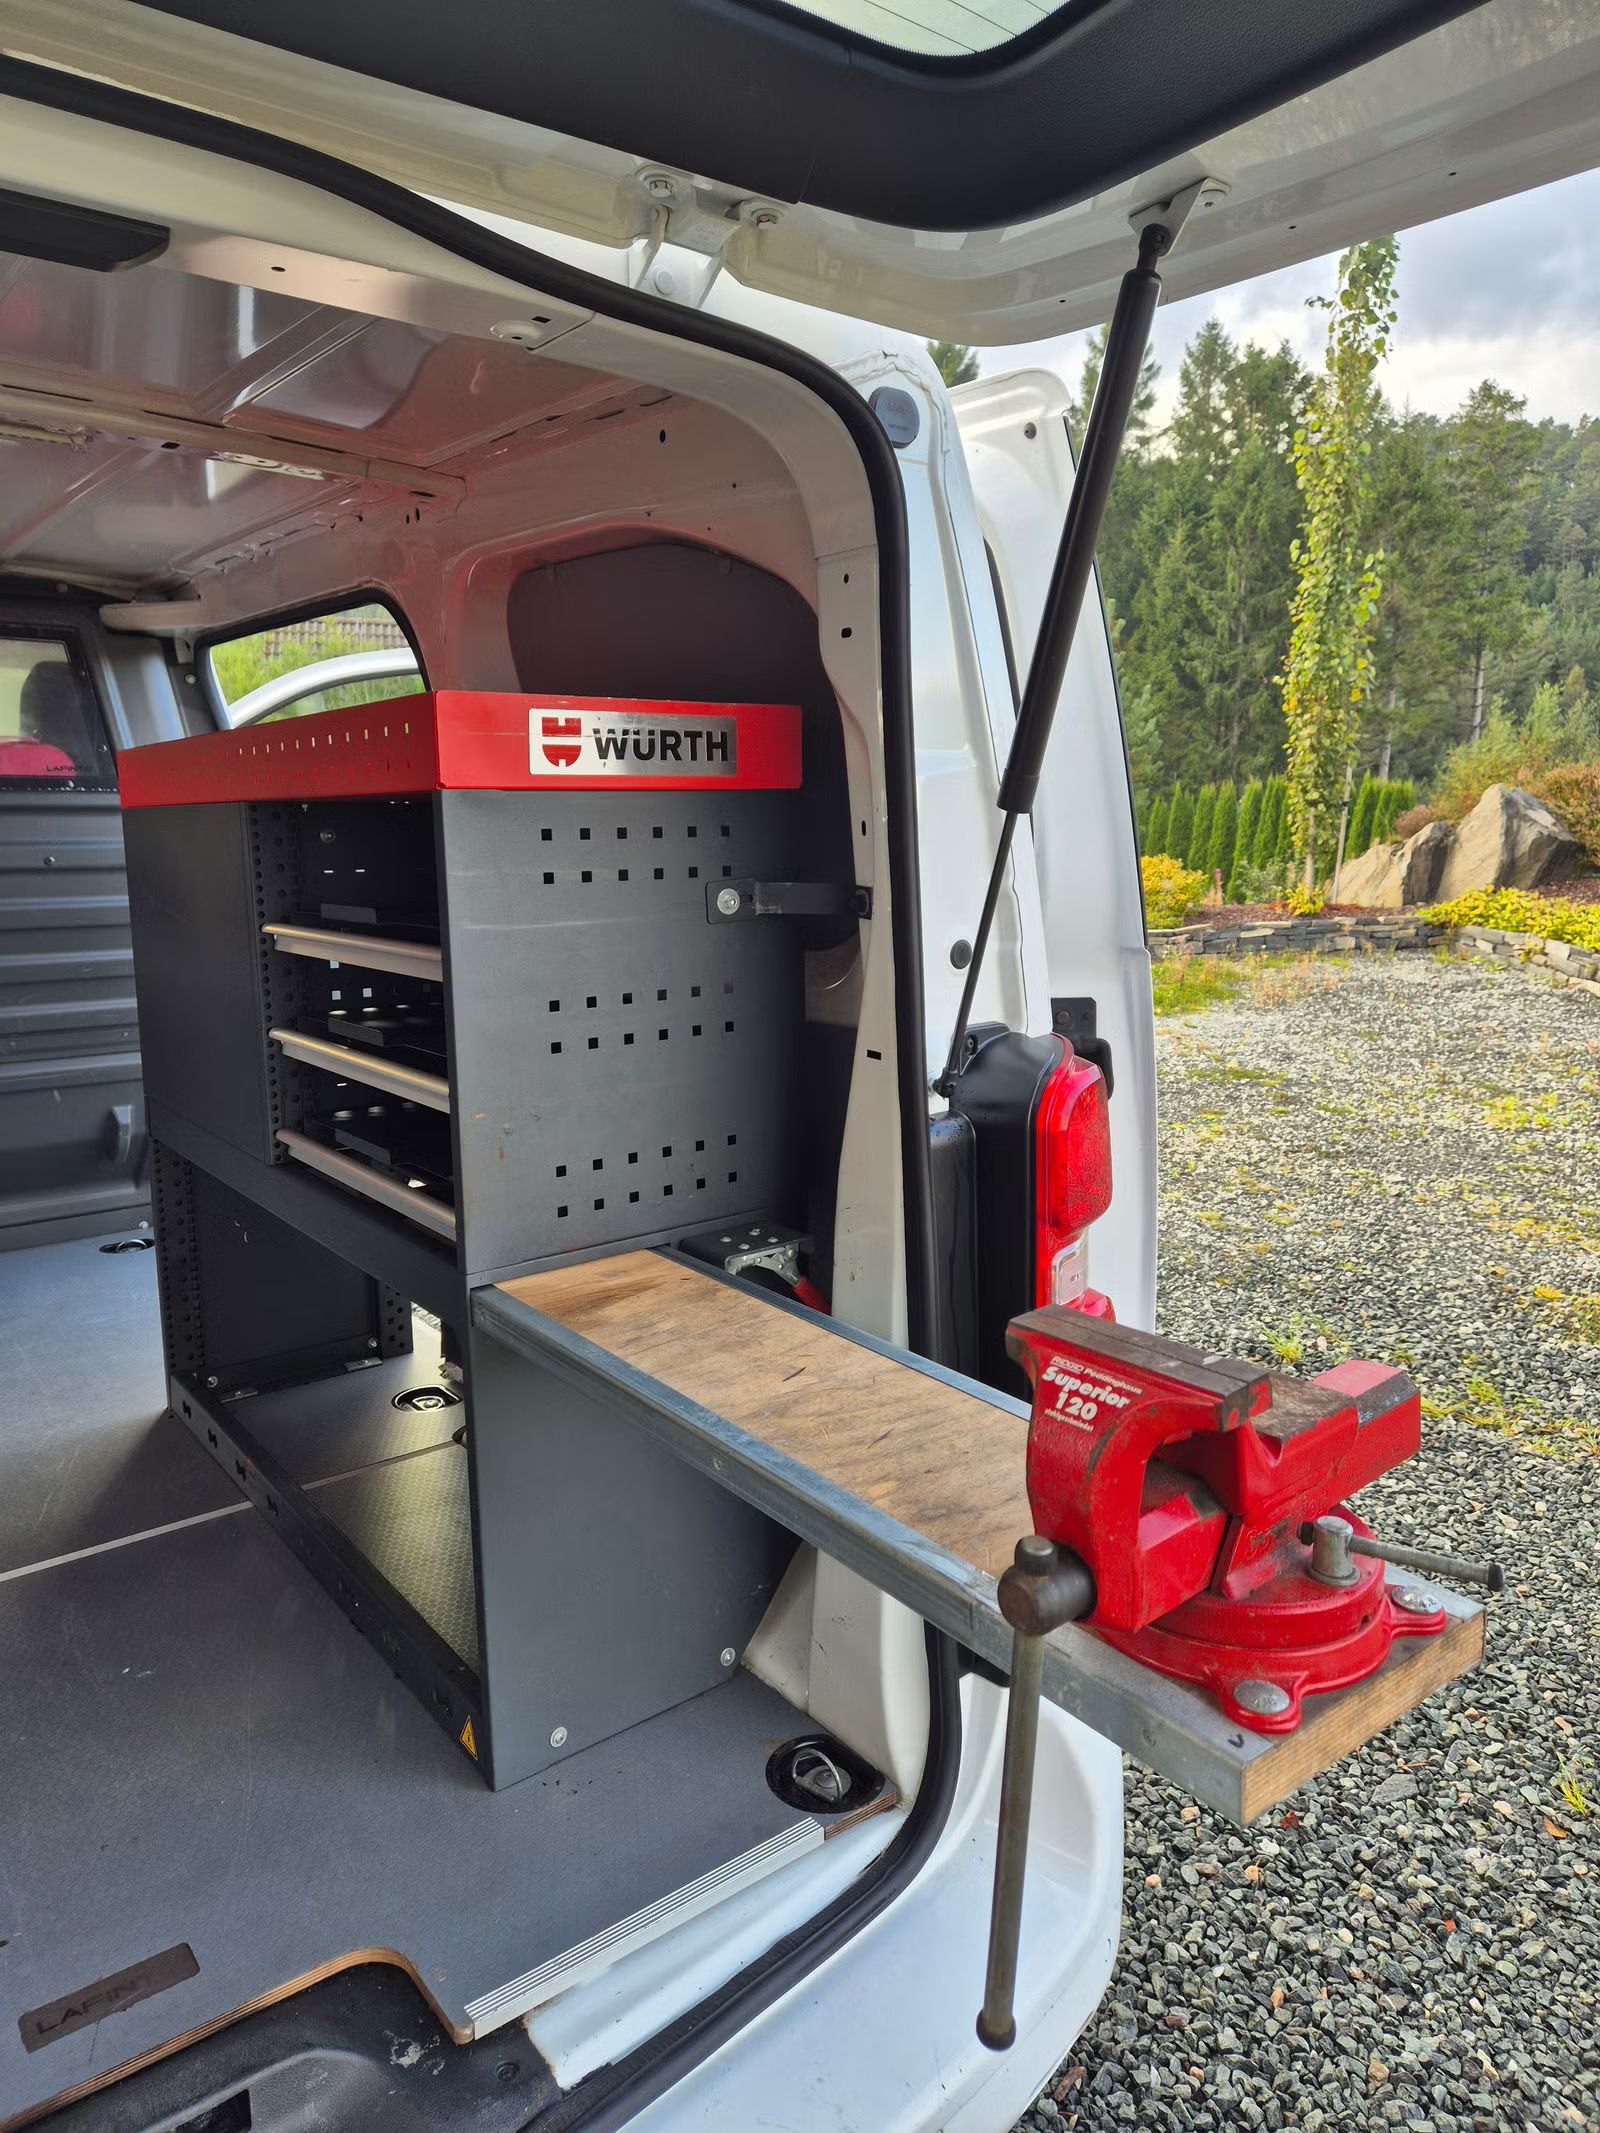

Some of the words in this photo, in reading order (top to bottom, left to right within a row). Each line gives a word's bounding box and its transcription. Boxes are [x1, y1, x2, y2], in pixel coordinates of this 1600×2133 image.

[592, 728, 729, 762] WÜRTH
[1042, 1366, 1130, 1408] Superior
[1050, 1356, 1085, 1374] RIDGID
[1084, 1368, 1143, 1394] Peddinghaus
[1056, 1391, 1098, 1421] 120
